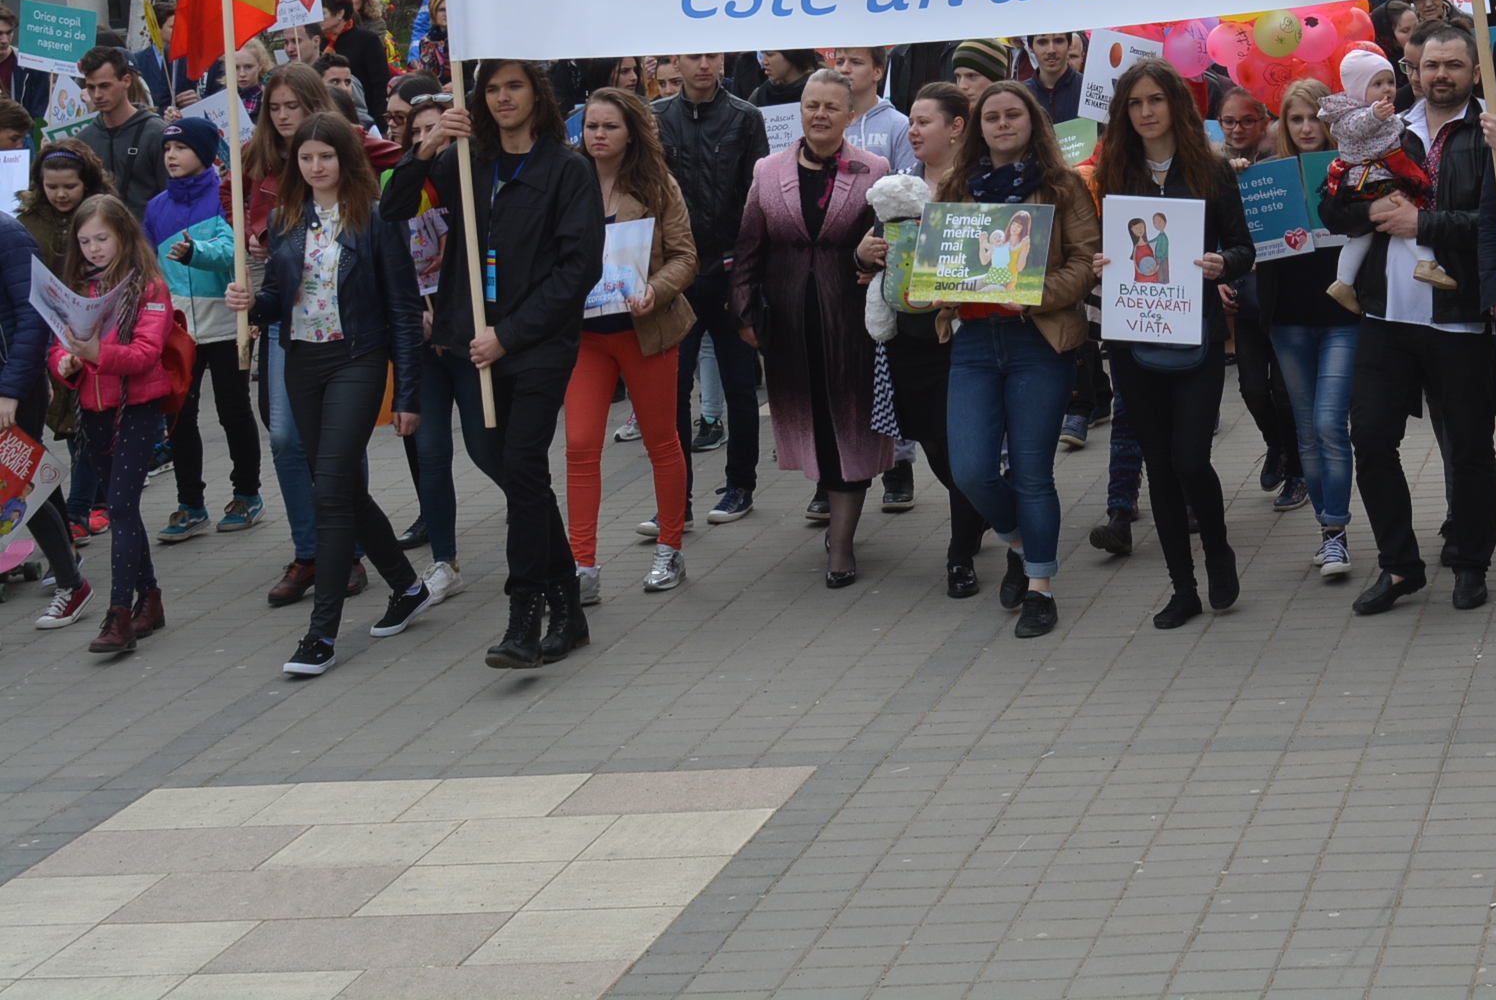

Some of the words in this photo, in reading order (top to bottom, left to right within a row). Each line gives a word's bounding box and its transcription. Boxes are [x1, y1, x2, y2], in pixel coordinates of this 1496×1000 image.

[33, 9, 57, 23] Orice
[58, 16, 81, 28] copil
[27, 23, 54, 36] merită
[64, 28, 72, 39] zi
[74, 30, 87, 41] de
[770, 114, 795, 123] născut
[1250, 177, 1274, 188] este
[1260, 202, 1284, 214] este
[945, 213, 992, 226] Femeile
[942, 227, 983, 239] merită
[940, 241, 963, 252] mai
[938, 253, 967, 265] mult
[936, 265, 970, 278] decât
[934, 279, 977, 292] avortul
[1139, 310, 1164, 322] aleg
[1126, 318, 1173, 337] VIAȚA
